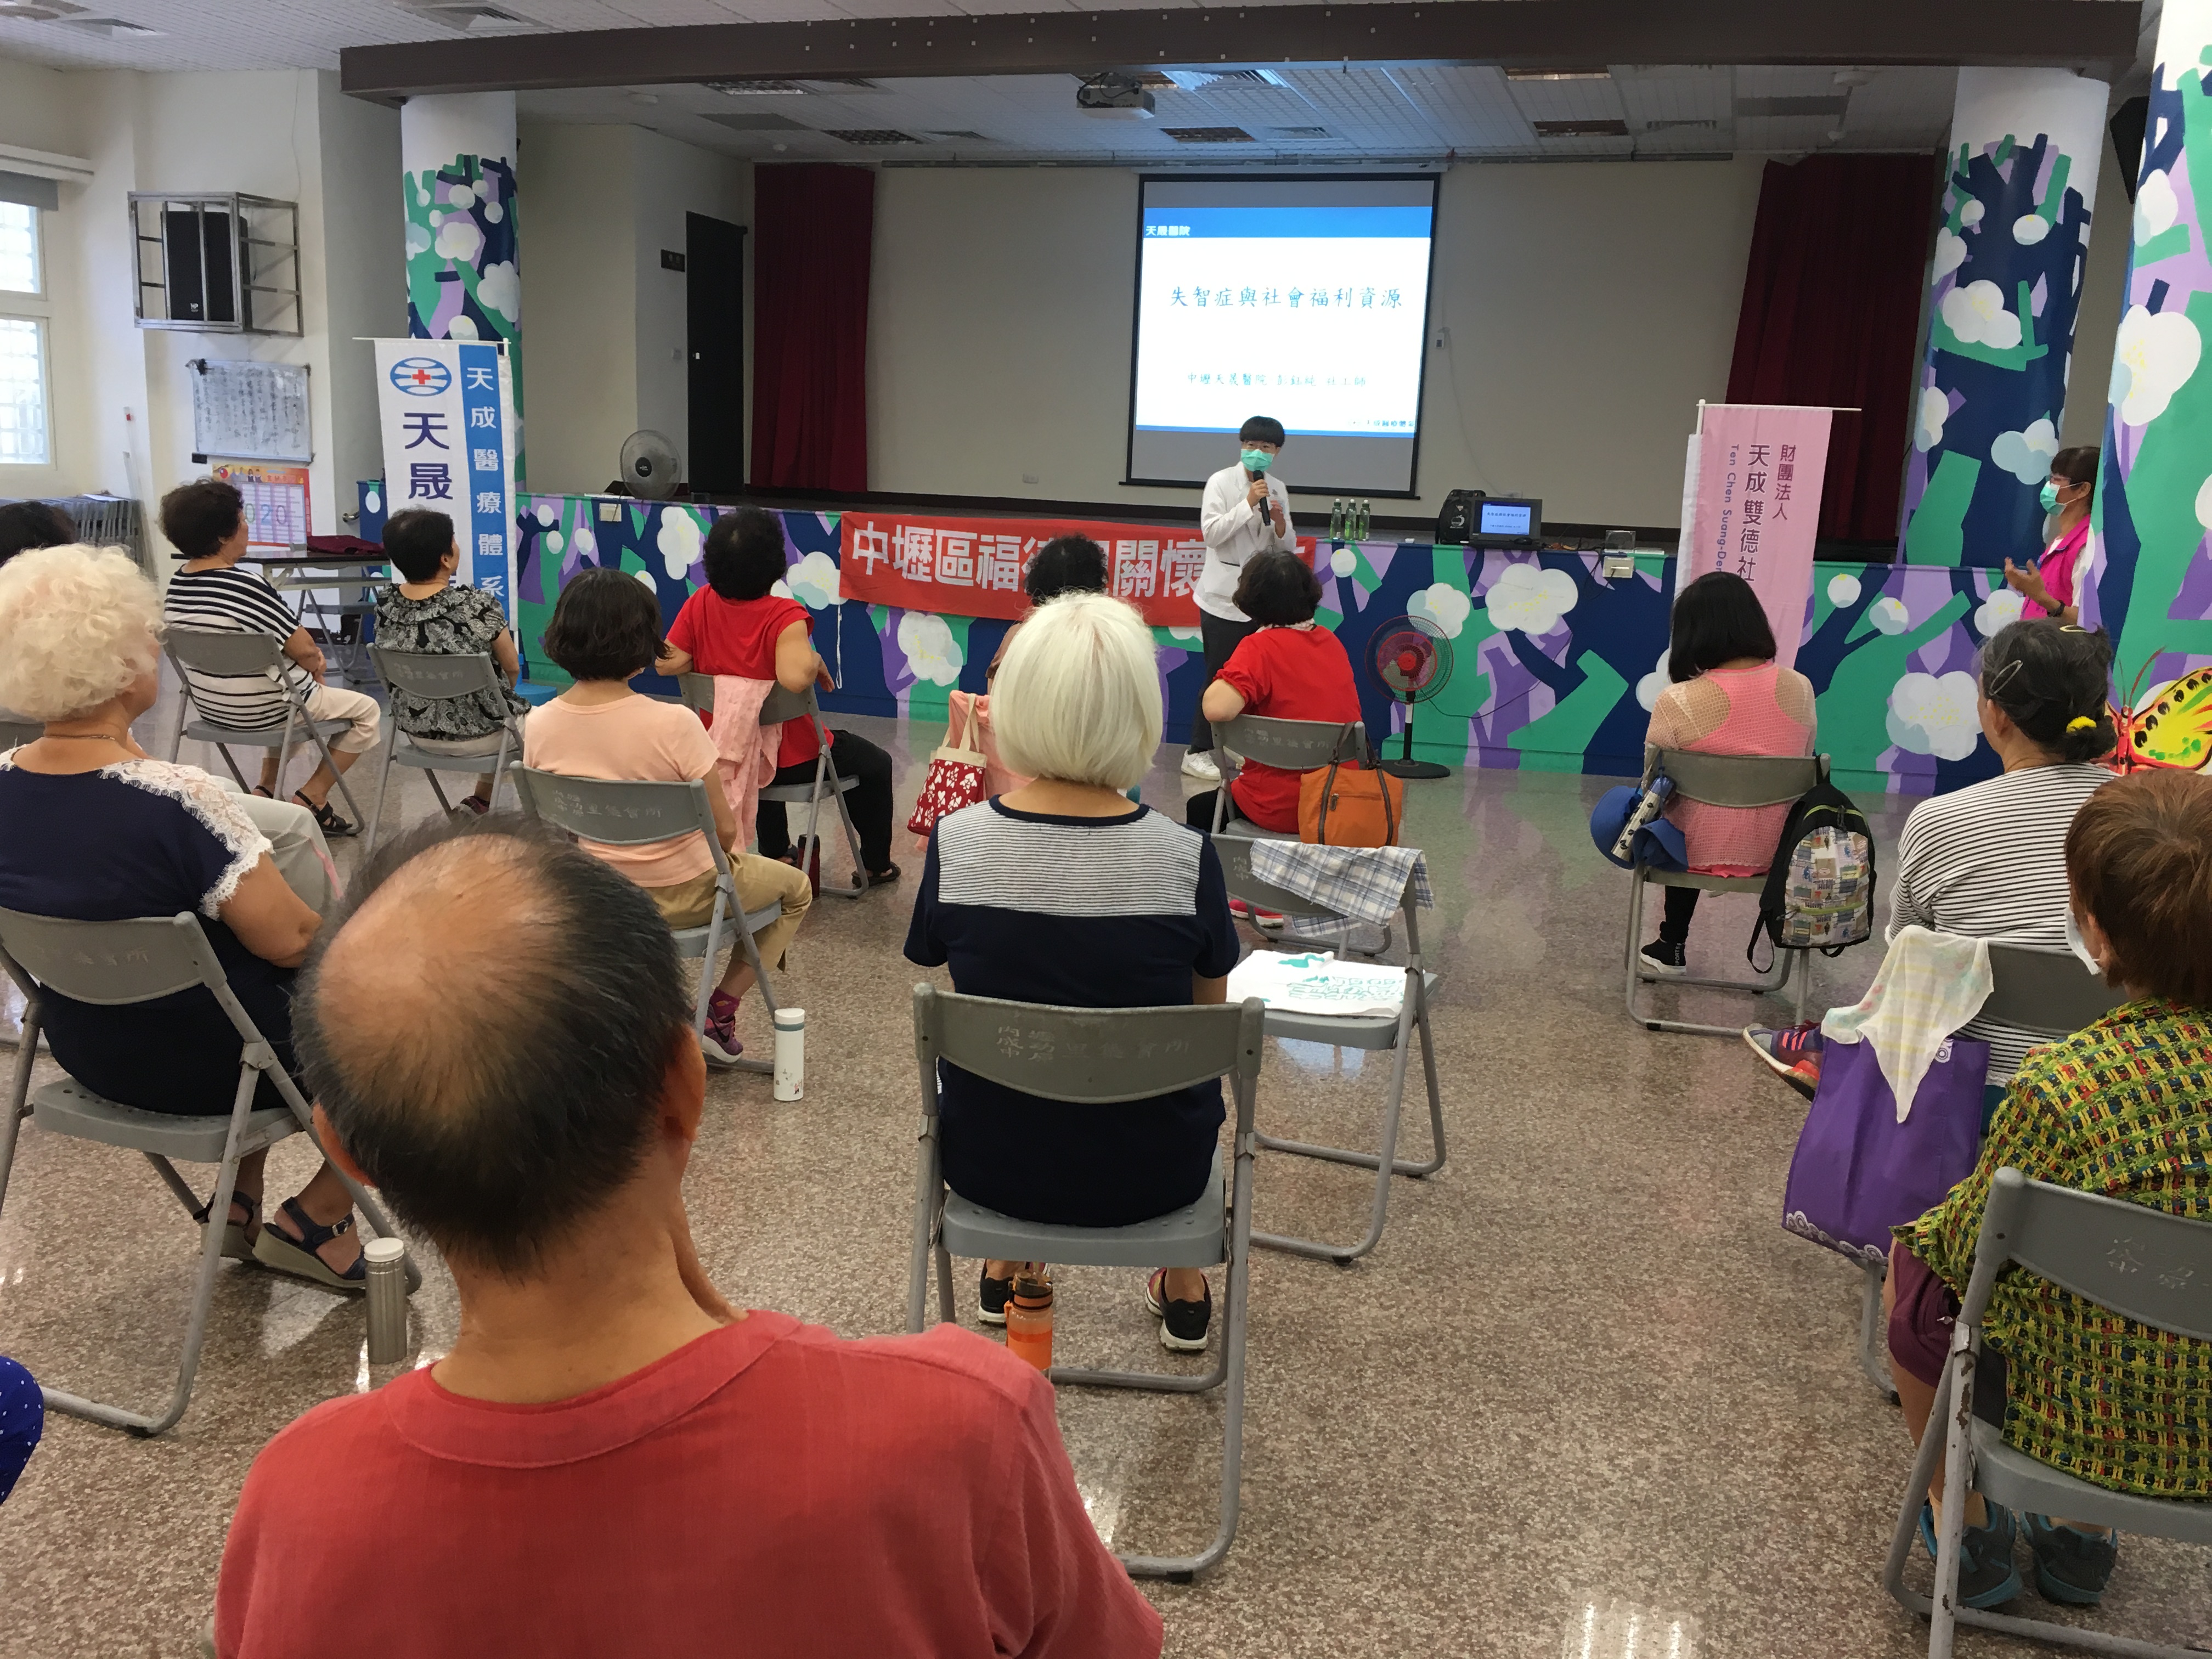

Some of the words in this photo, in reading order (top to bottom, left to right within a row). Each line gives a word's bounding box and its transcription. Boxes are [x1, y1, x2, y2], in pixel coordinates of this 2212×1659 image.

[1170, 285, 1403, 309] 失智症與社會福利資源
[466, 366, 505, 598] 天成醫療體系
[1724, 472, 1736, 503] Chen
[1730, 444, 1740, 466] Ten
[1772, 444, 1796, 521] 財團法人
[1736, 443, 1770, 582] 天成雙德社
[852, 521, 1305, 598] 中壢區福關懷
